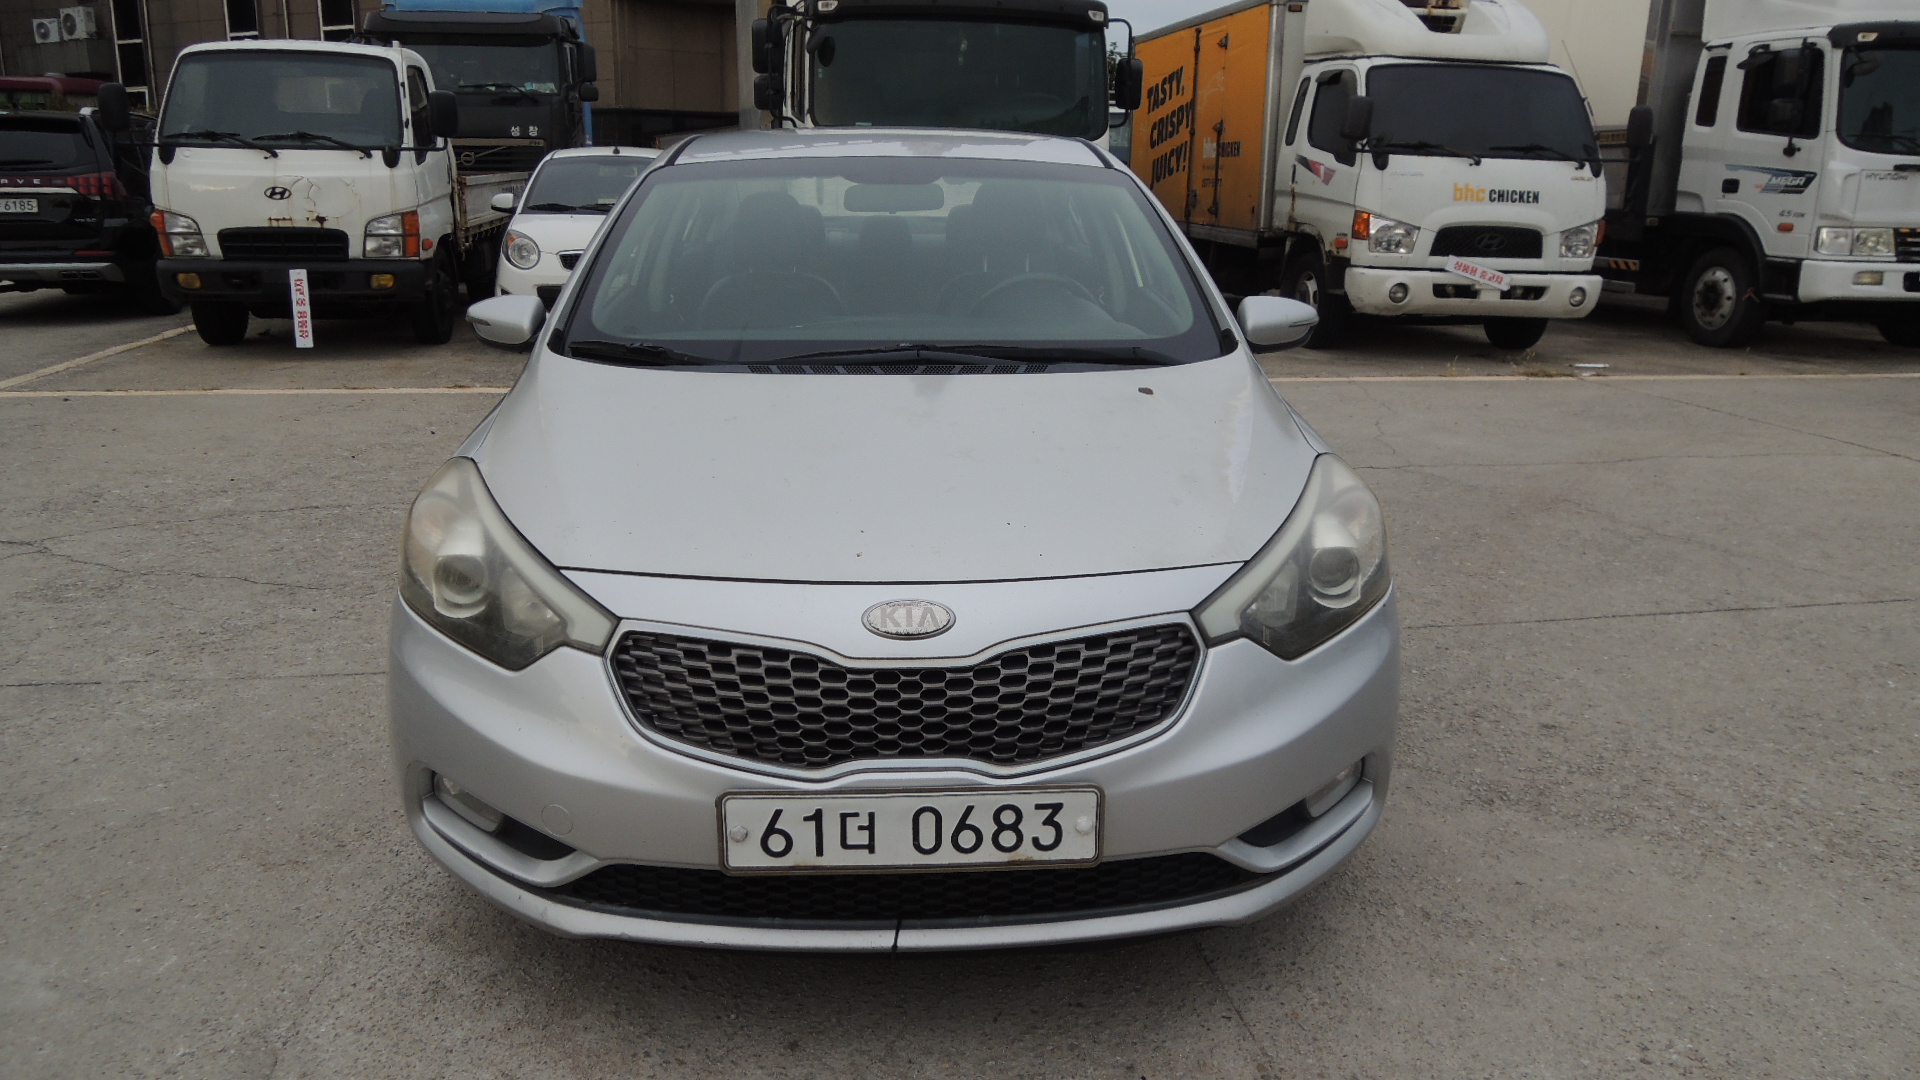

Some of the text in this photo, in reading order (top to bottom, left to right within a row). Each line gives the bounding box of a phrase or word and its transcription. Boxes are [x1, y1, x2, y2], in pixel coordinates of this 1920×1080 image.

[1150, 98, 1195, 149] CRISPY
[1150, 140, 1188, 190] JUICY!
[1769, 177, 1806, 185] MEGA
[1453, 182, 1540, 204] bhc CHICKEN
[4, 200, 33, 211] 6185
[880, 606, 940, 628] KIA
[759, 802, 1065, 858] 61더 0683
